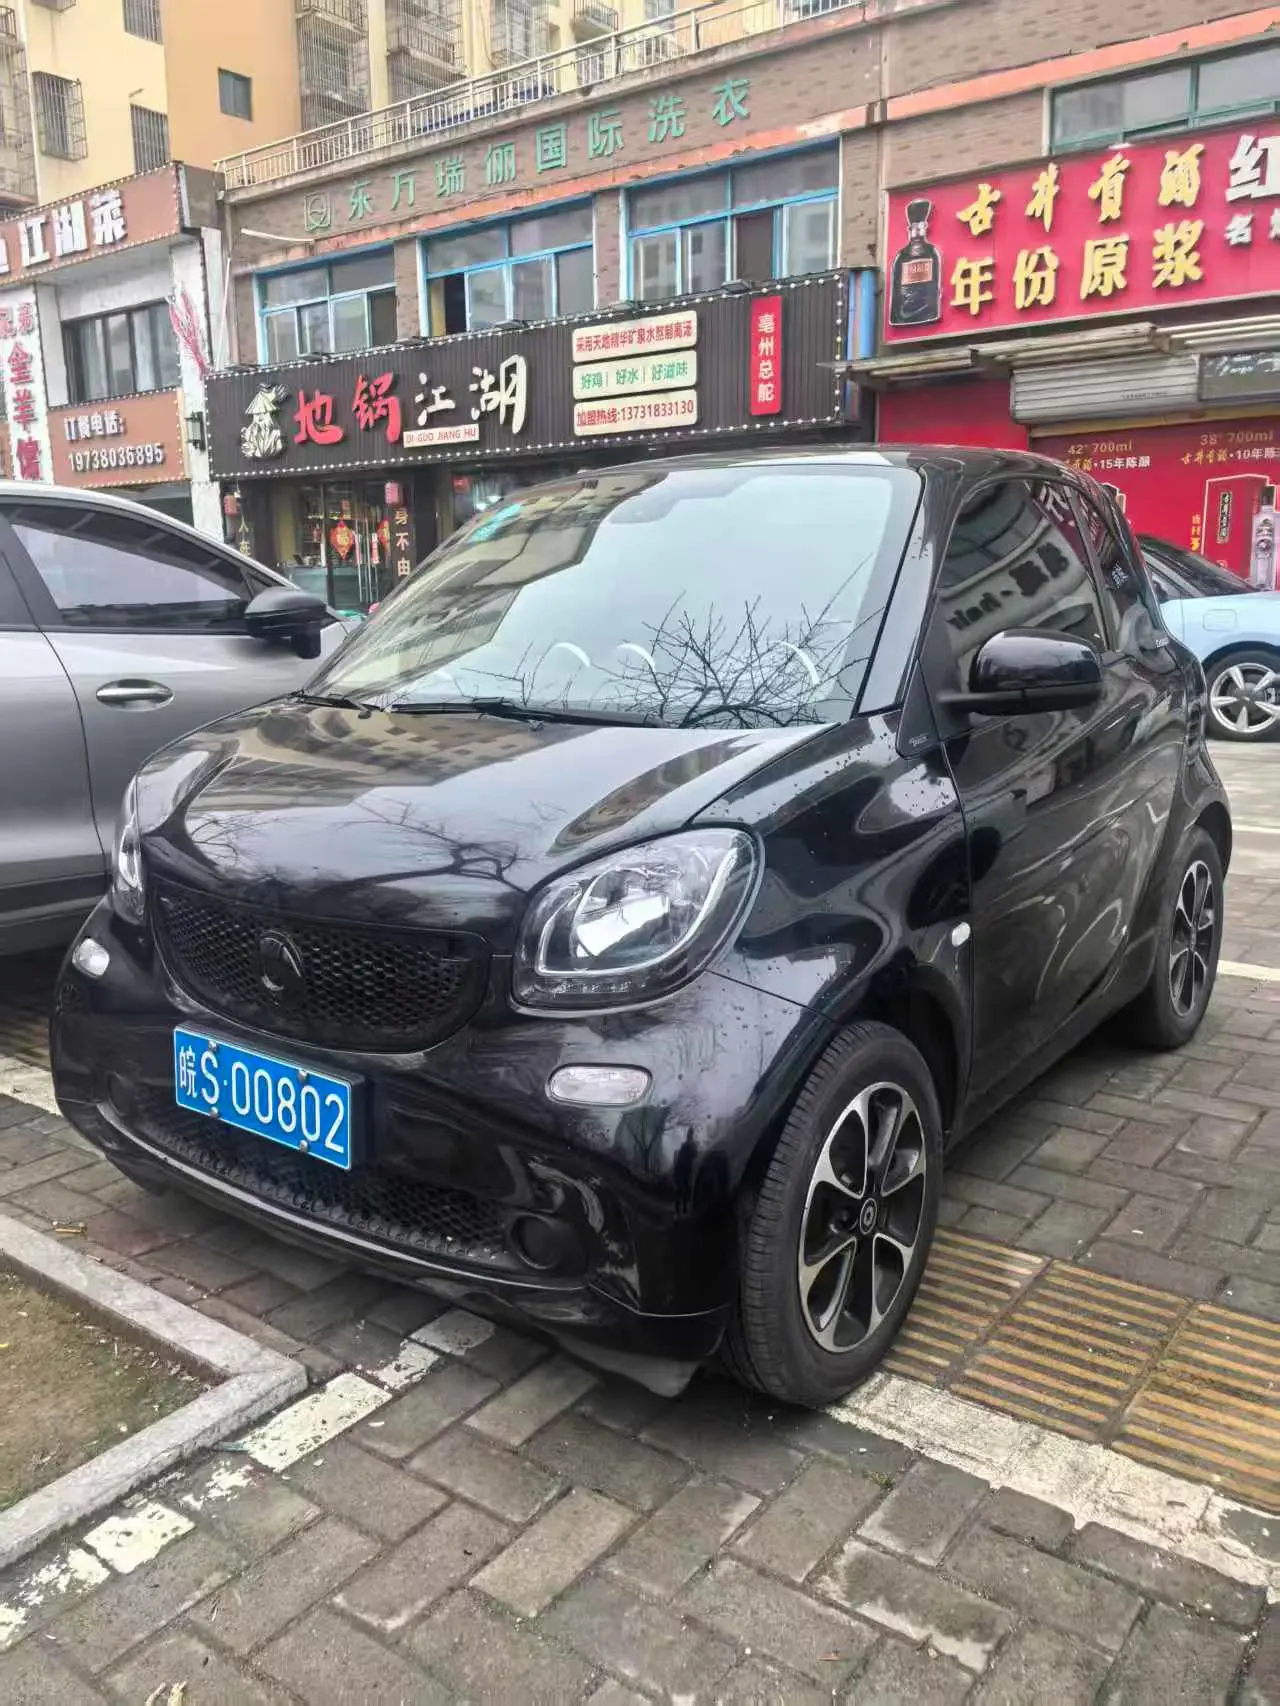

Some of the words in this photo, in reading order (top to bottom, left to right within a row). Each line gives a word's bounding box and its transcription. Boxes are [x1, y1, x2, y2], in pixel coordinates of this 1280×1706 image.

[1225, 134, 1280, 203] 红
[956, 143, 1206, 237] 古井贡酒
[1224, 206, 1280, 246] 名
[950, 220, 1206, 316] 年份原浆
[615, 367, 639, 385] 好水
[293, 354, 527, 445] 地锅江湖
[463, 427, 476, 438] HU
[1091, 440, 1133, 453] 700ml
[1226, 430, 1274, 442] 700ml
[68, 442, 164, 472] 19738036895
